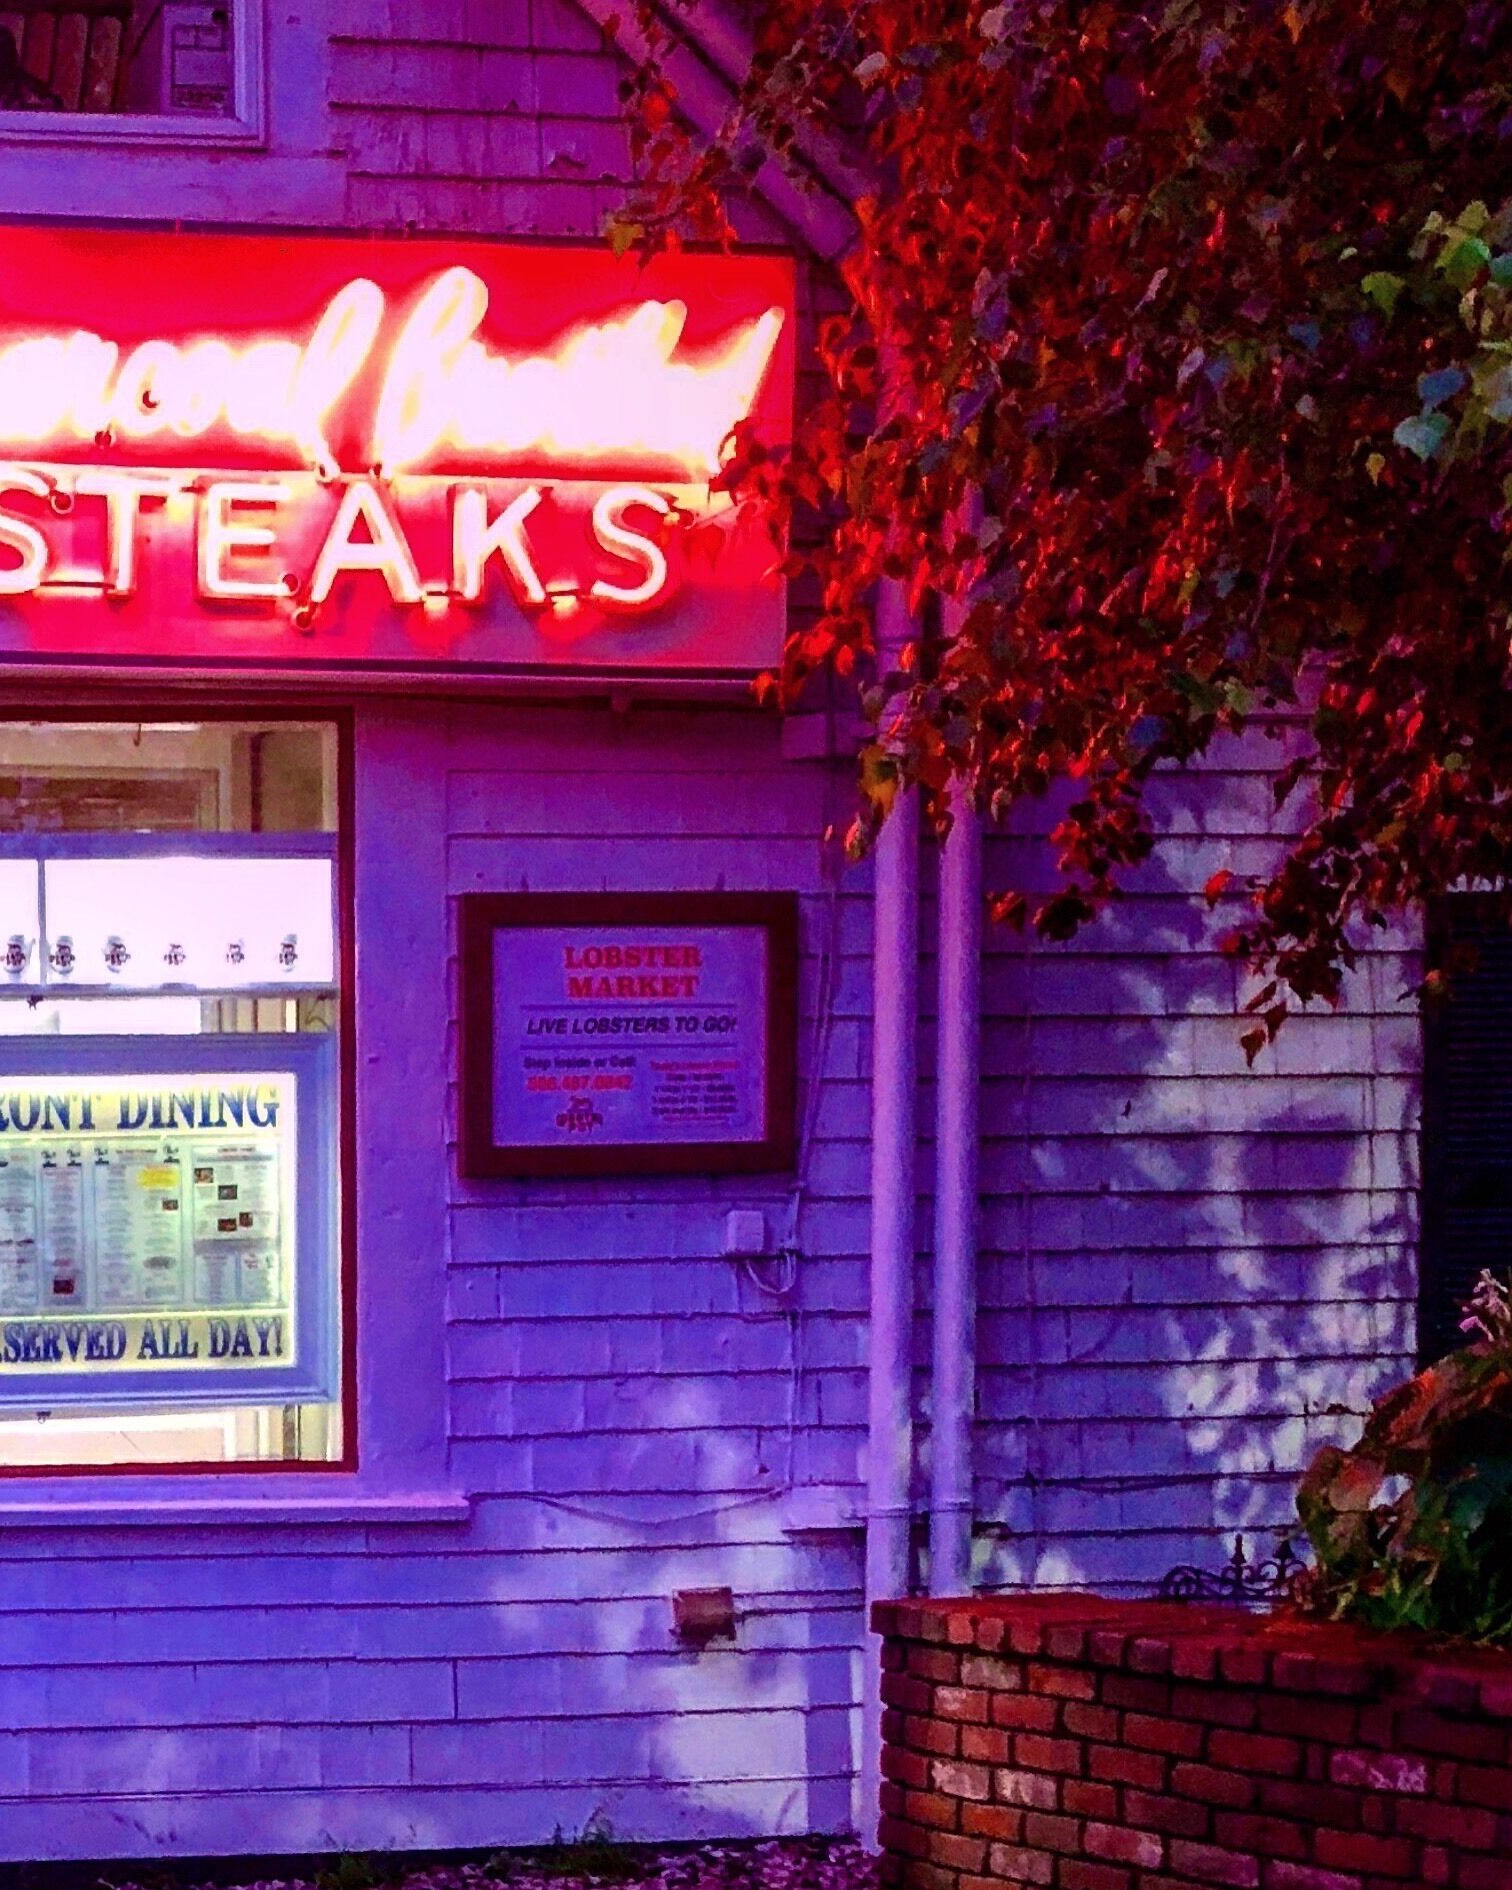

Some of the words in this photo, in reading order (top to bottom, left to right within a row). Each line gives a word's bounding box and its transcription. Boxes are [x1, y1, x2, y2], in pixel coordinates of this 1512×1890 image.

[564, 946, 702, 969] LOBSTER
[567, 976, 699, 998] MARKET
[527, 1017, 568, 1035] LIVE
[572, 1016, 670, 1035] LOBSTERS
[674, 1016, 699, 1033] TO
[702, 1015, 737, 1033] GO!
[116, 1084, 281, 1129] DINING
[138, 1319, 199, 1361] ALL
[207, 1316, 285, 1359] DAY!
